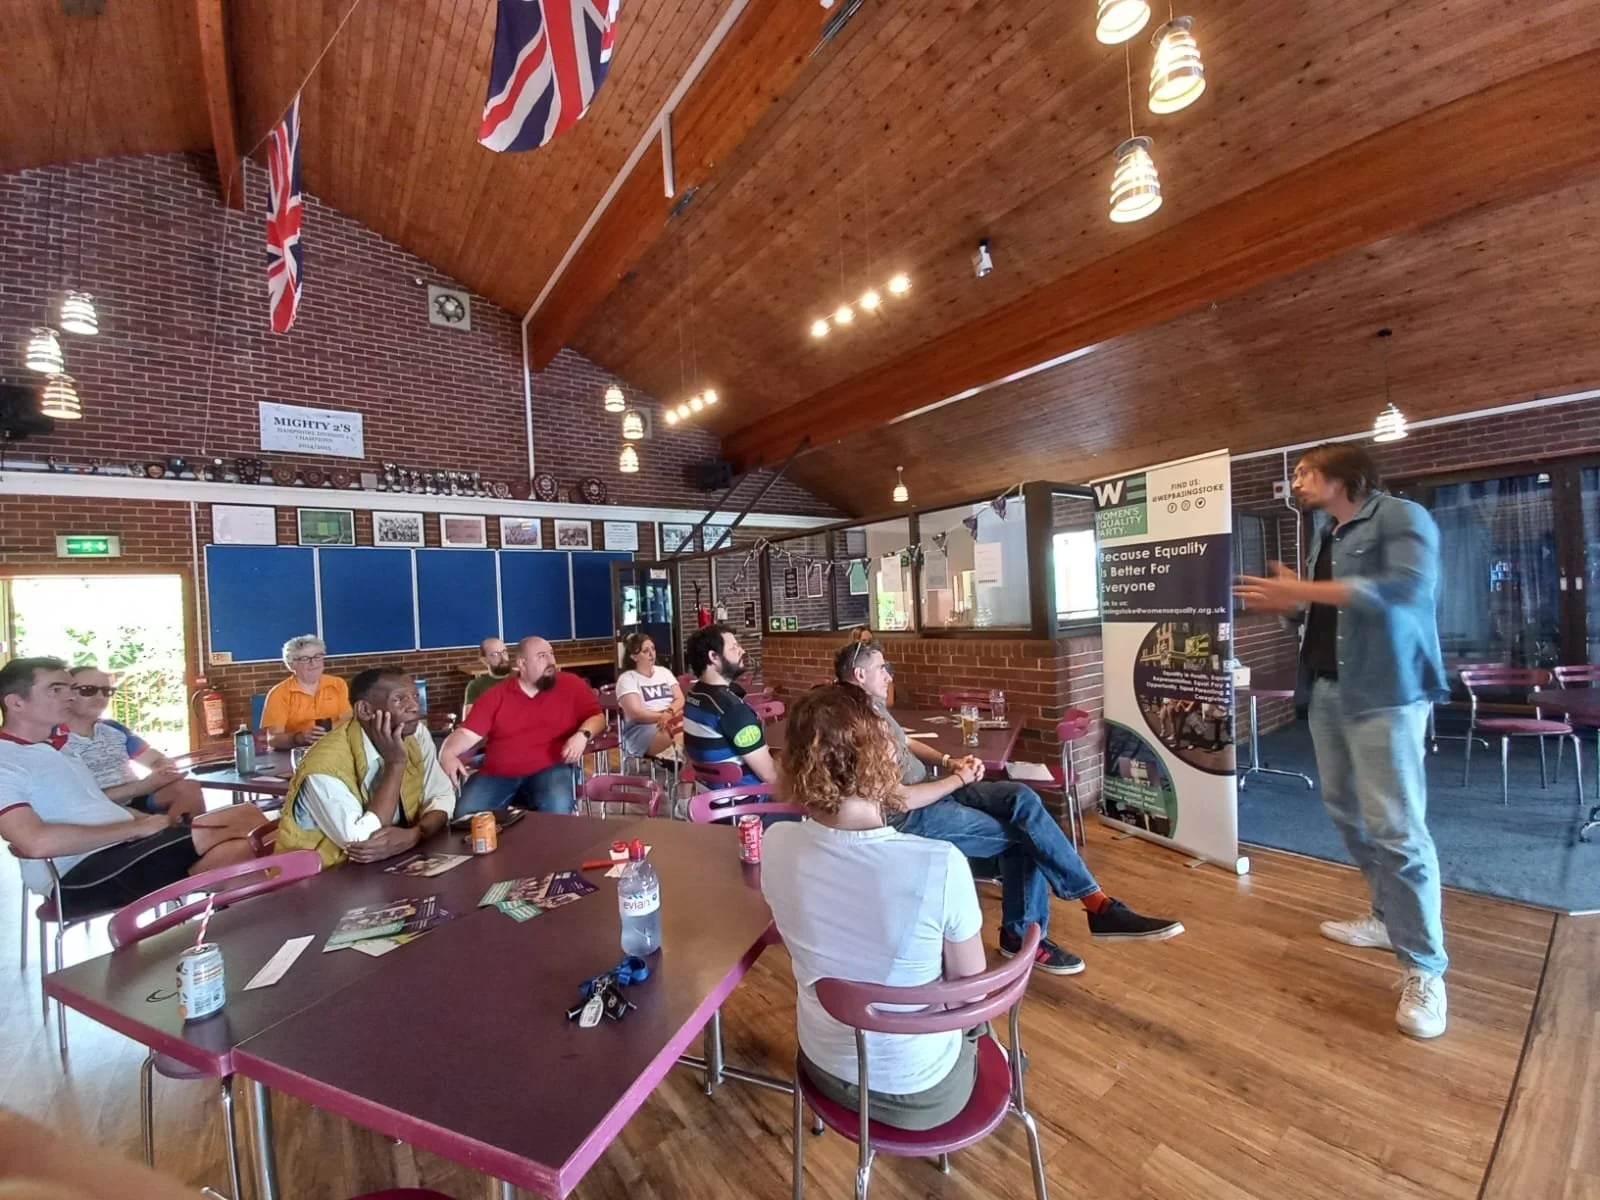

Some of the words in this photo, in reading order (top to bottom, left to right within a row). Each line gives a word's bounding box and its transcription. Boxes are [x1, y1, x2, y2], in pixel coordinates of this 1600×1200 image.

[274, 416, 330, 430] MIGHTY
[333, 423, 352, 433] 2'S
[1171, 481, 1187, 490] FIND
[1155, 541, 1207, 559] Equality
[1111, 564, 1146, 577] Better
[1150, 563, 1171, 575] For
[1101, 581, 1156, 594] Everyone
[623, 899, 650, 910] evian
